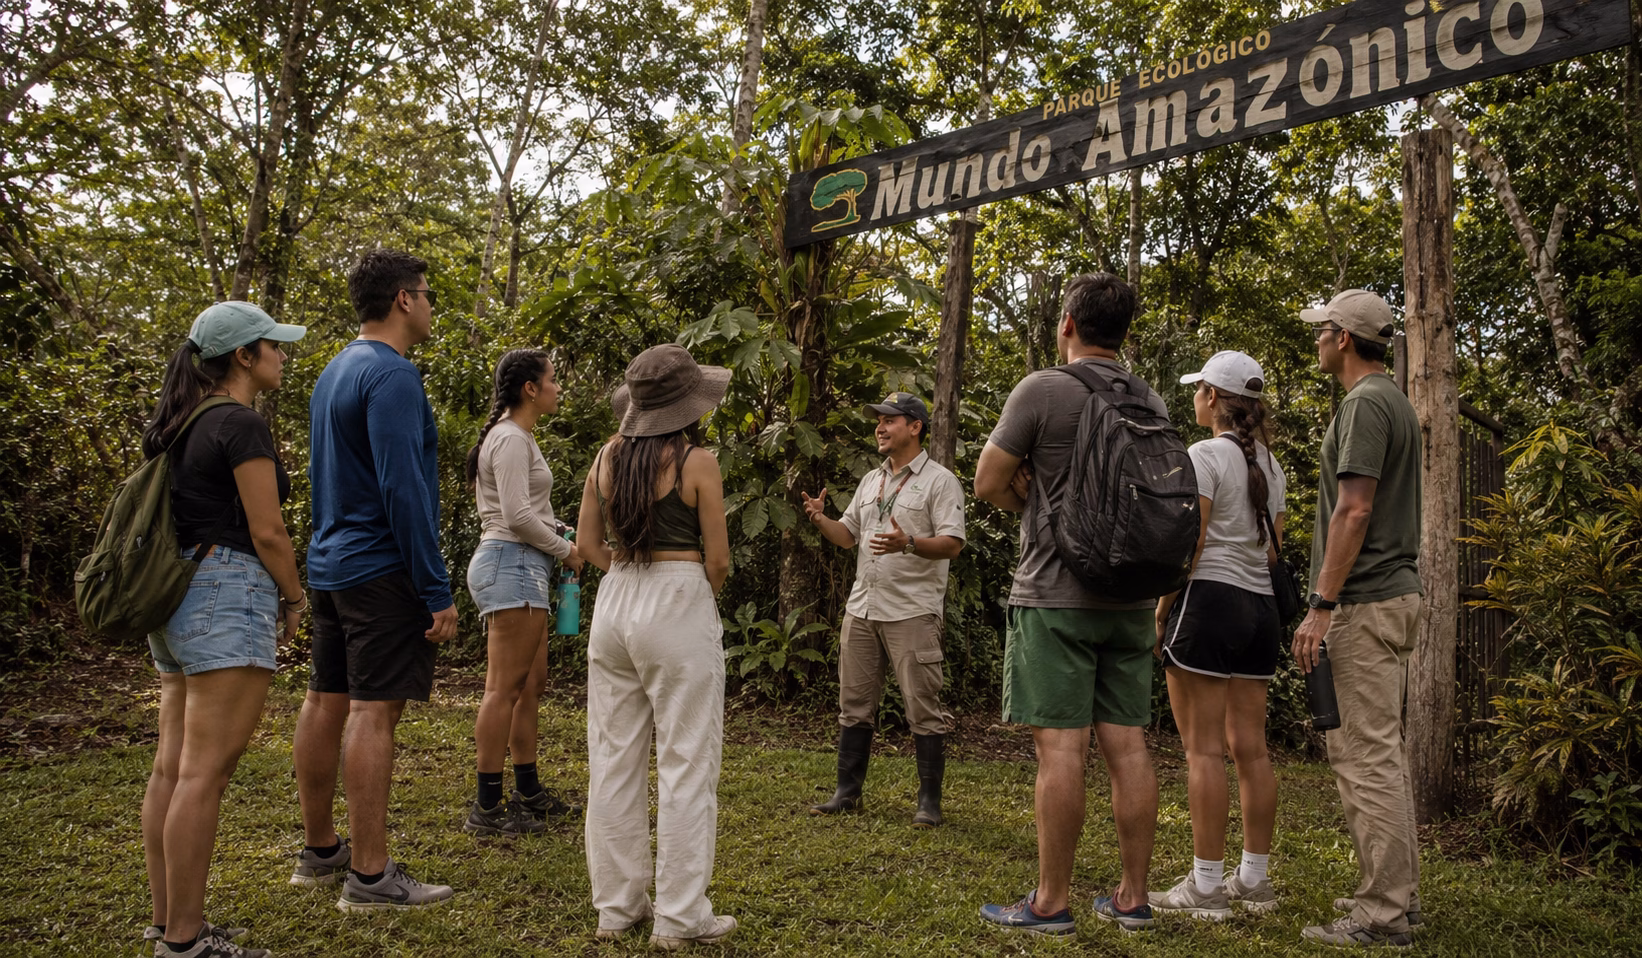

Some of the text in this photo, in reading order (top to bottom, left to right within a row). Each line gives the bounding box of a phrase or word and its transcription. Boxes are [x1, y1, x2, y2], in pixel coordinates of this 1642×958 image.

[870, 0, 1545, 222] Mundo Amazónico
[1042, 29, 1272, 121] PARQUE ECOLÓGICO
